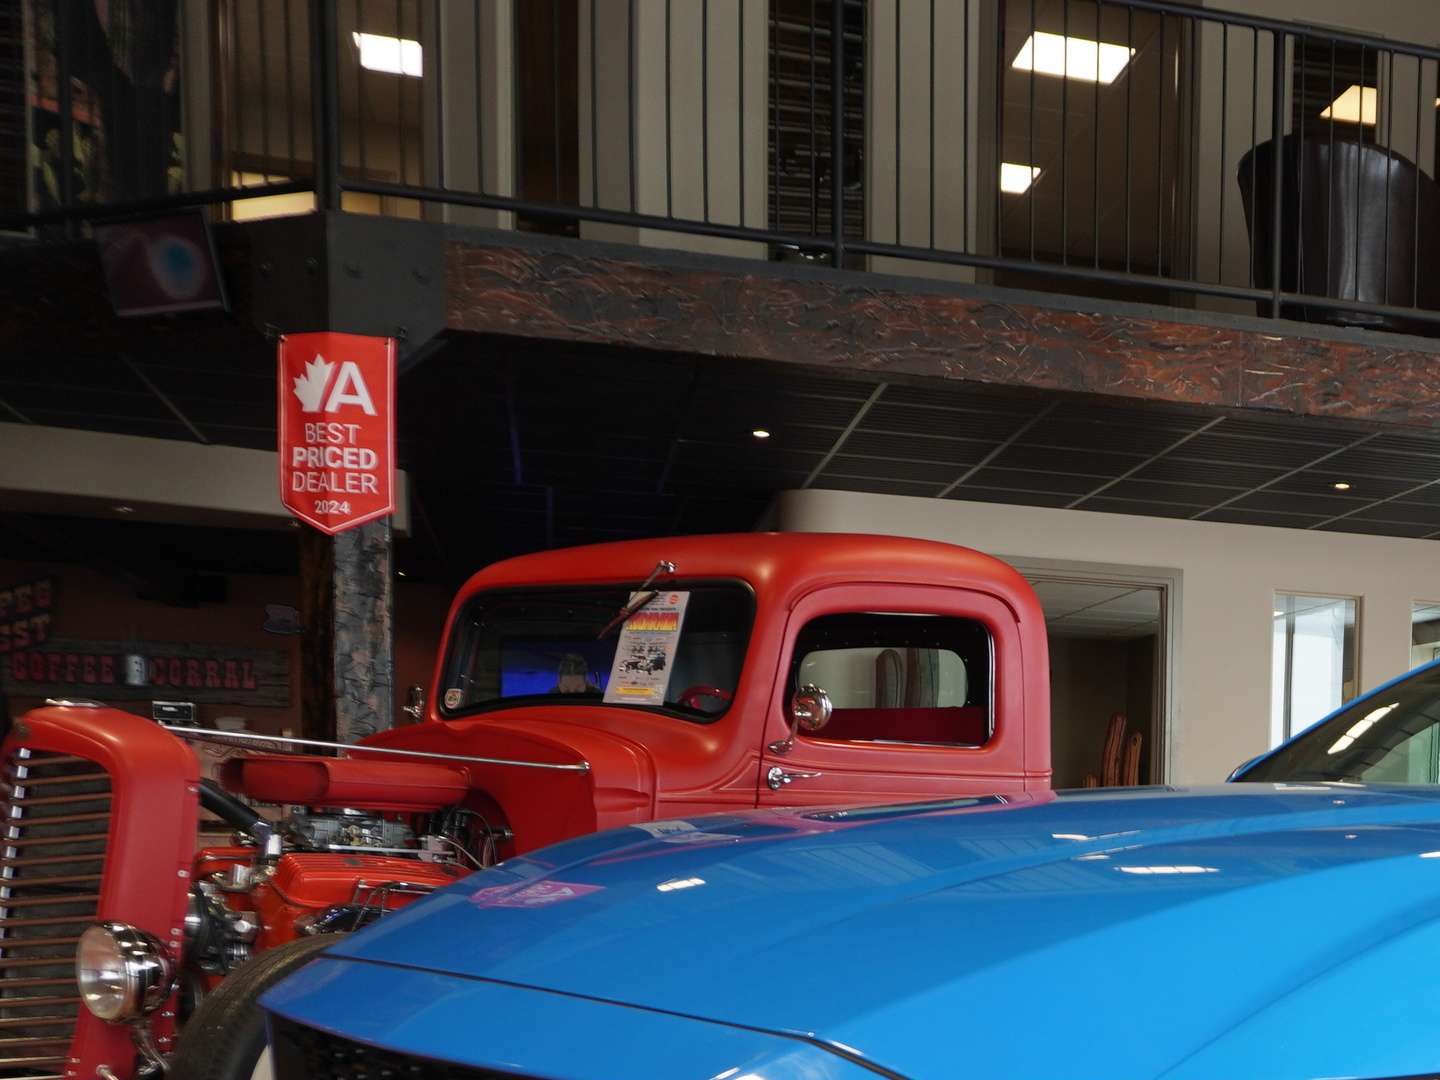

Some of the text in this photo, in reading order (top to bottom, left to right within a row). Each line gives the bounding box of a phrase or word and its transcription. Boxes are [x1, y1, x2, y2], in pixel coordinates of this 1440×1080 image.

[305, 422, 361, 444] BEST
[292, 446, 378, 469] PRICED
[292, 471, 379, 494] DEALER
[314, 500, 351, 514] 2024
[13, 651, 257, 690] COFFEE CORRAL
